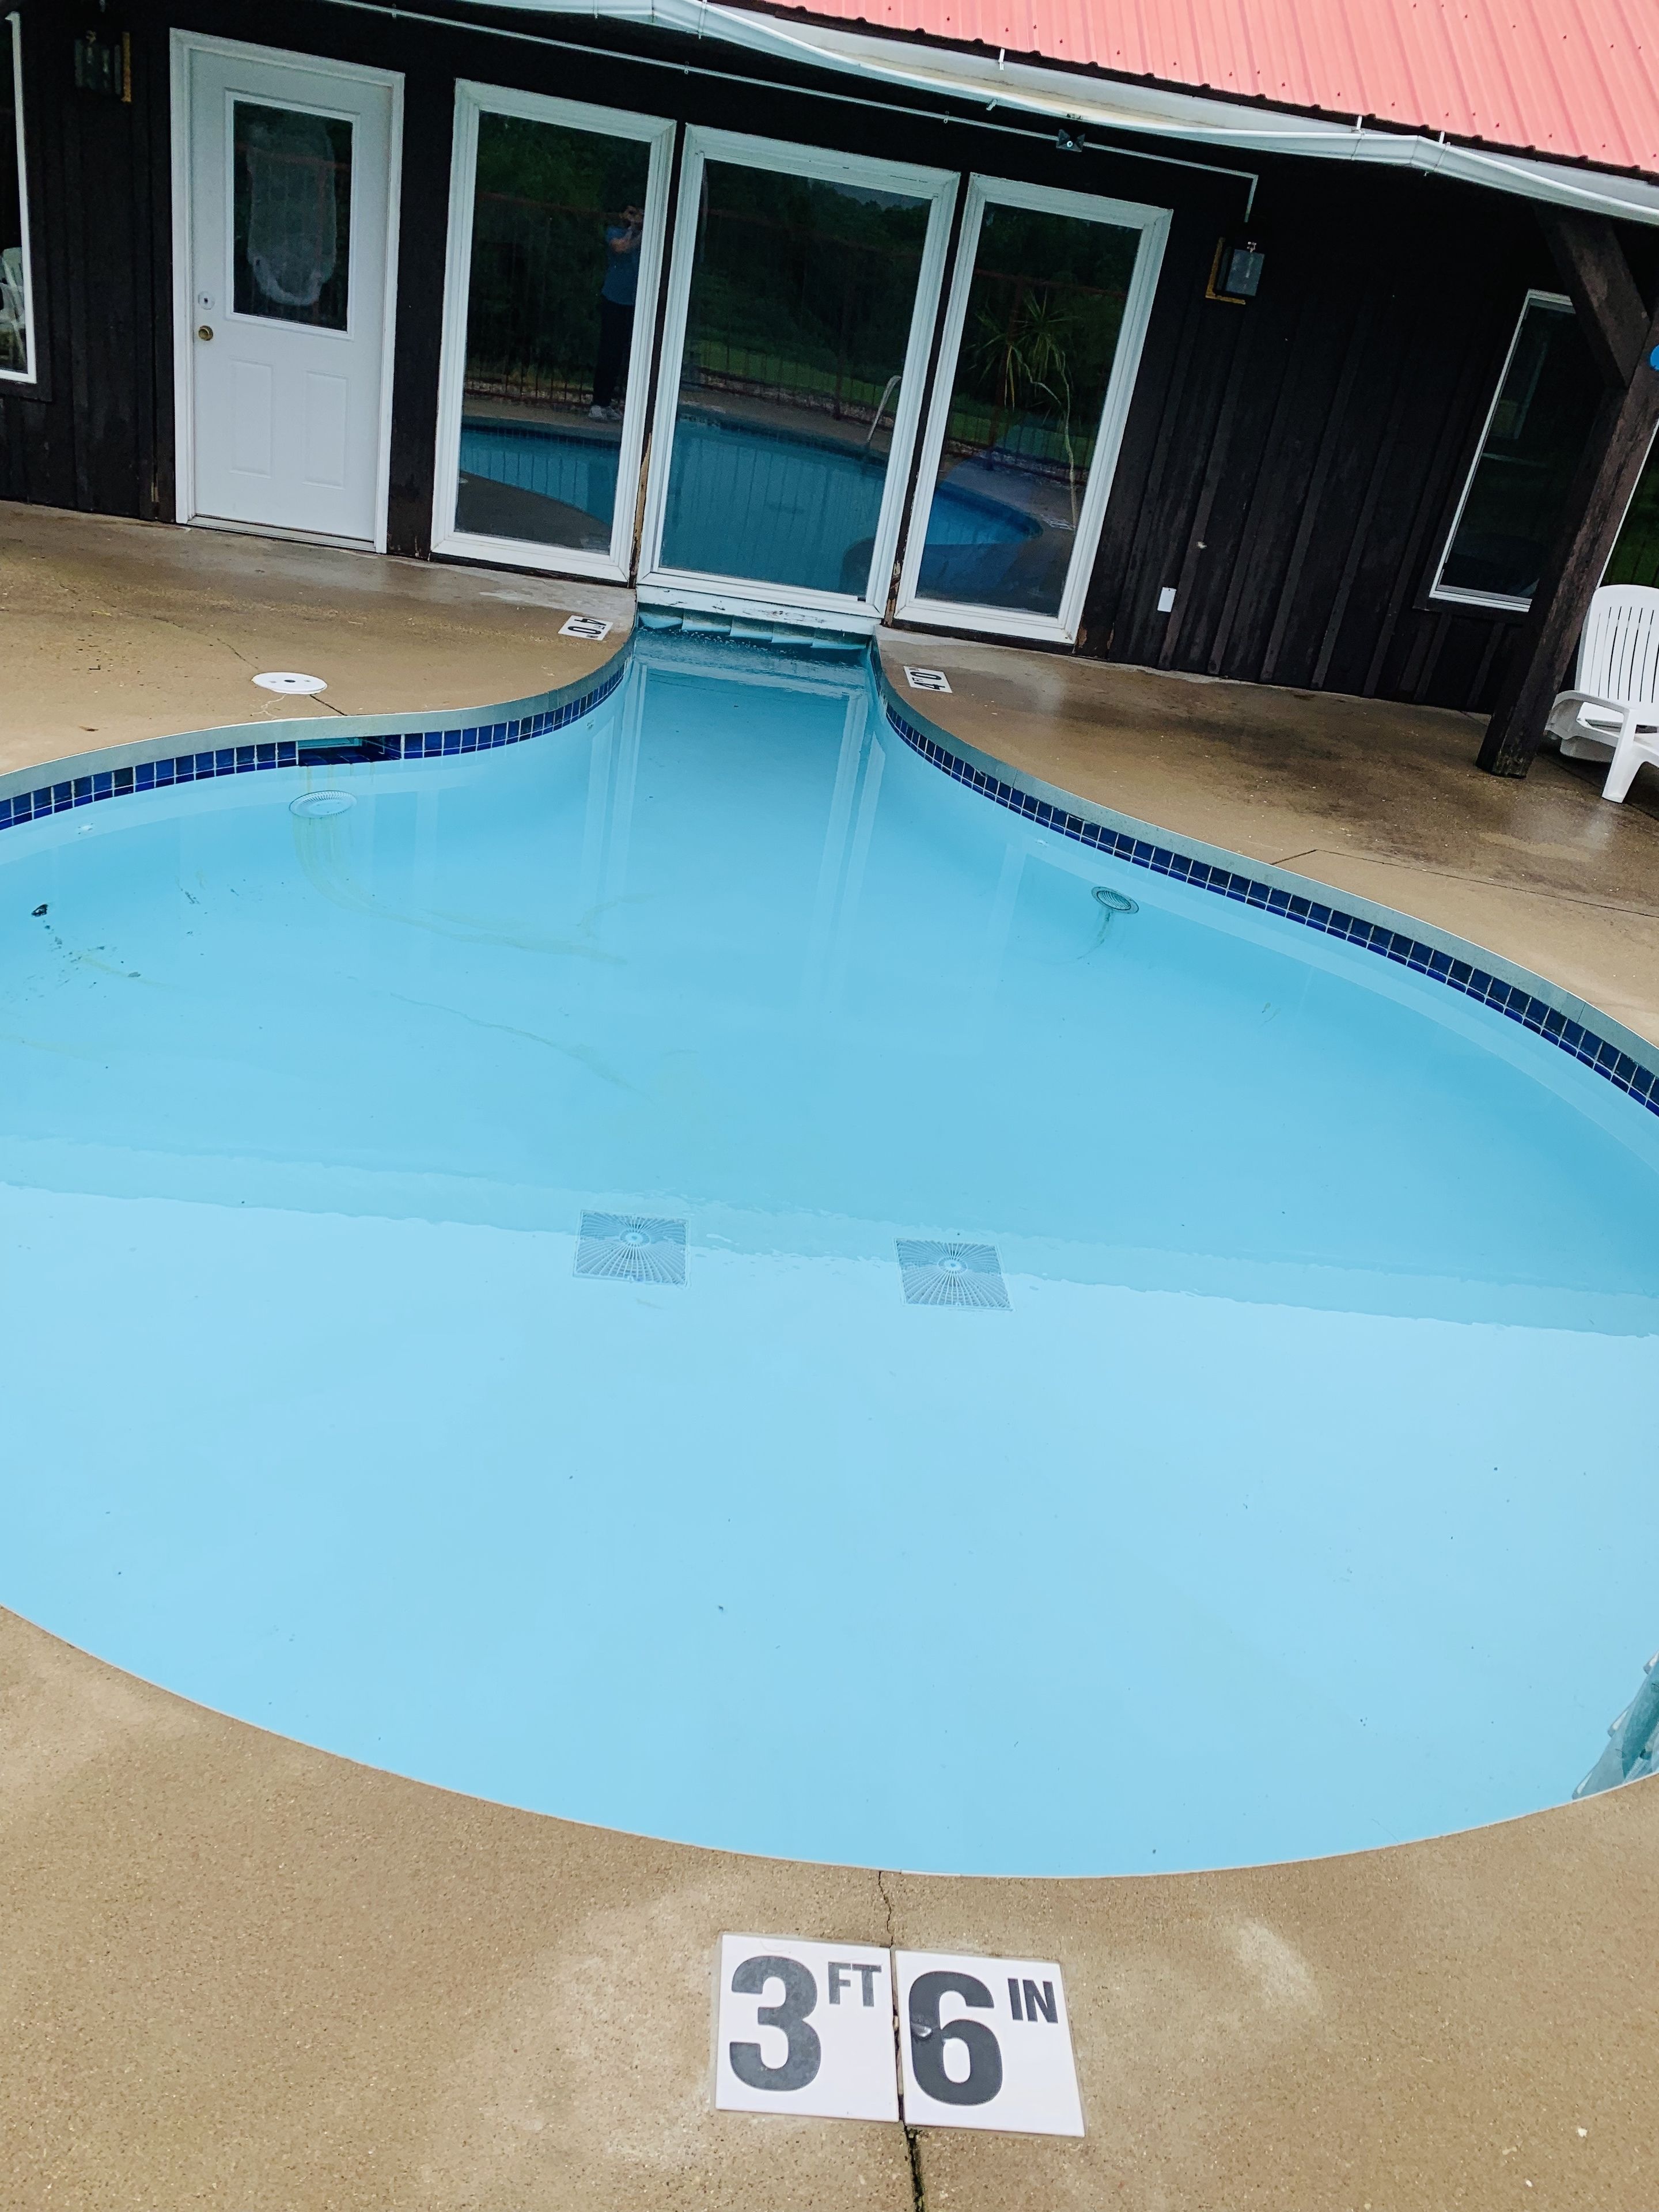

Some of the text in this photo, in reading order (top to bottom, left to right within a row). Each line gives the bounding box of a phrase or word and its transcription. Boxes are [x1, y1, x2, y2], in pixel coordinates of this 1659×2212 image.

[914, 681, 945, 690] 4
[729, 1956, 1058, 2106] 3 FT 6 IN
